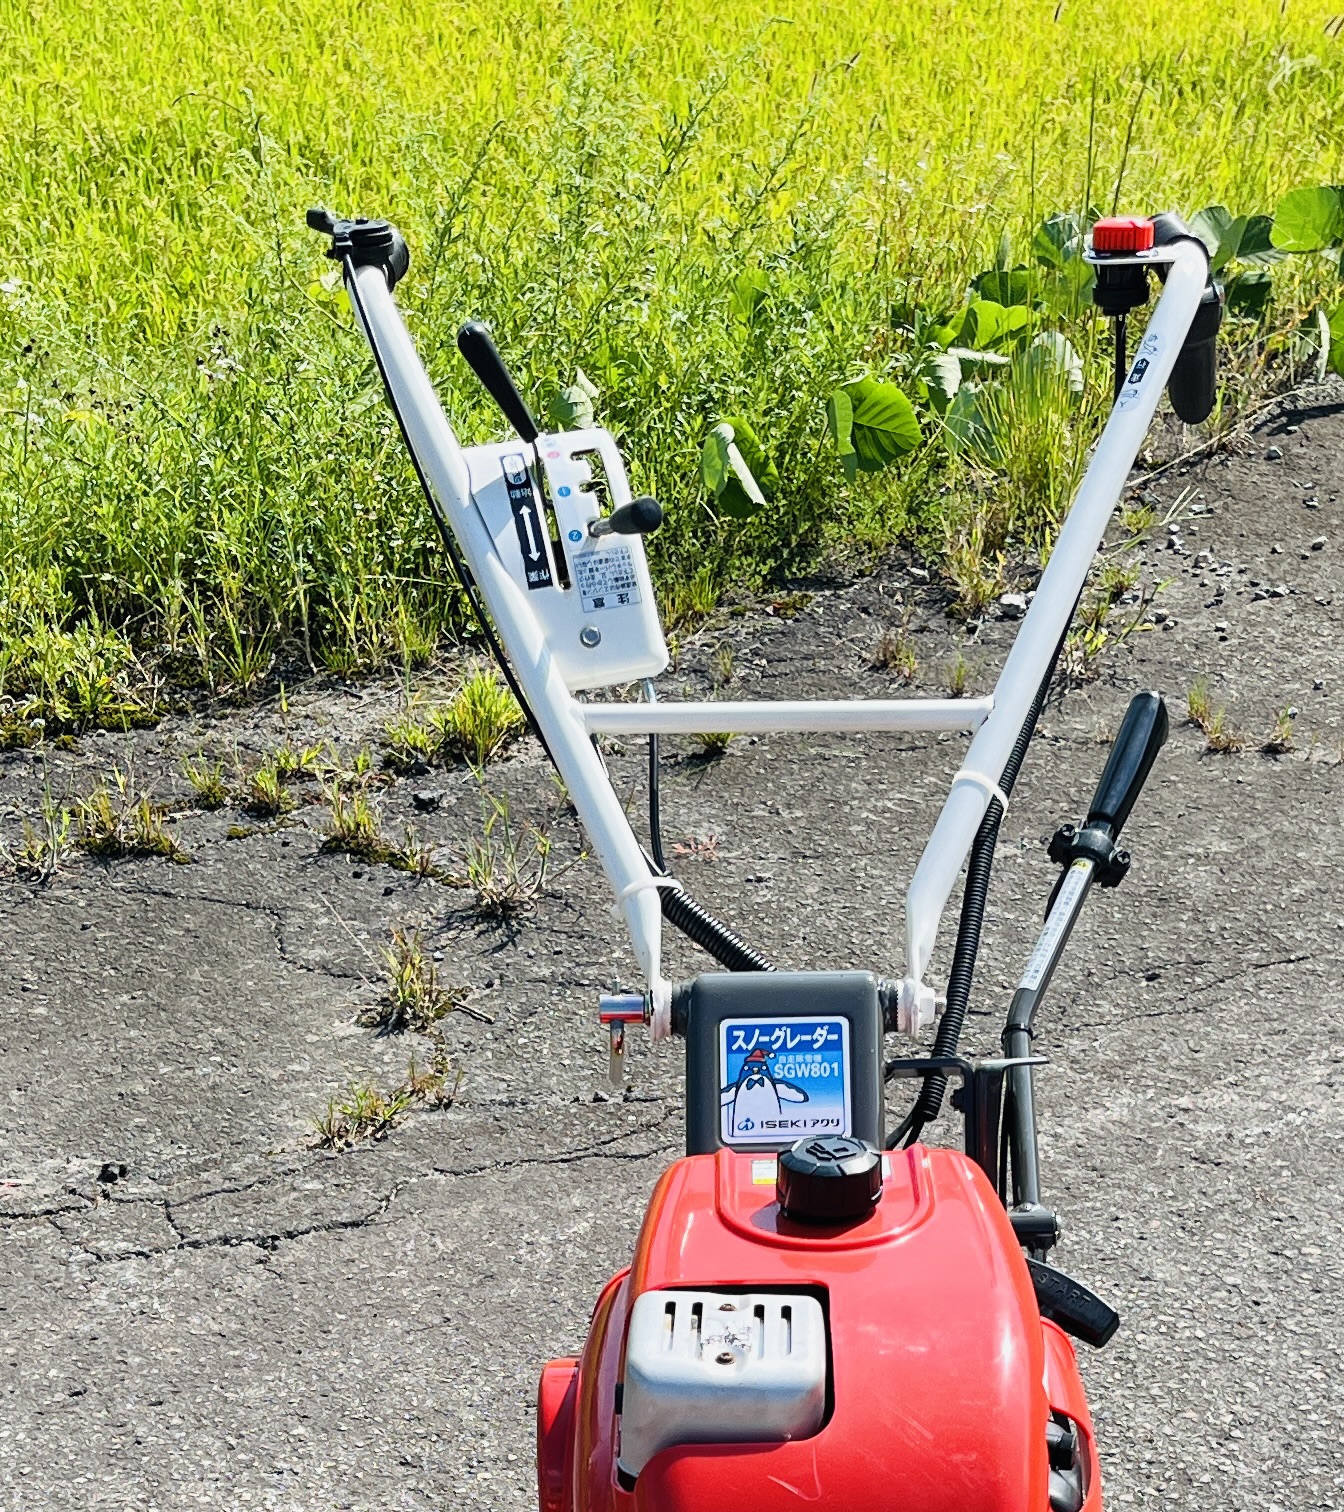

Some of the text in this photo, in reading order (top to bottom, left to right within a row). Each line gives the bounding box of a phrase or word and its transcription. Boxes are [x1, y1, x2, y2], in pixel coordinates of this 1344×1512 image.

[731, 1024, 839, 1051] スノーグレーダー
[773, 1061, 839, 1079] SGW801
[1037, 1271, 1092, 1308] START
